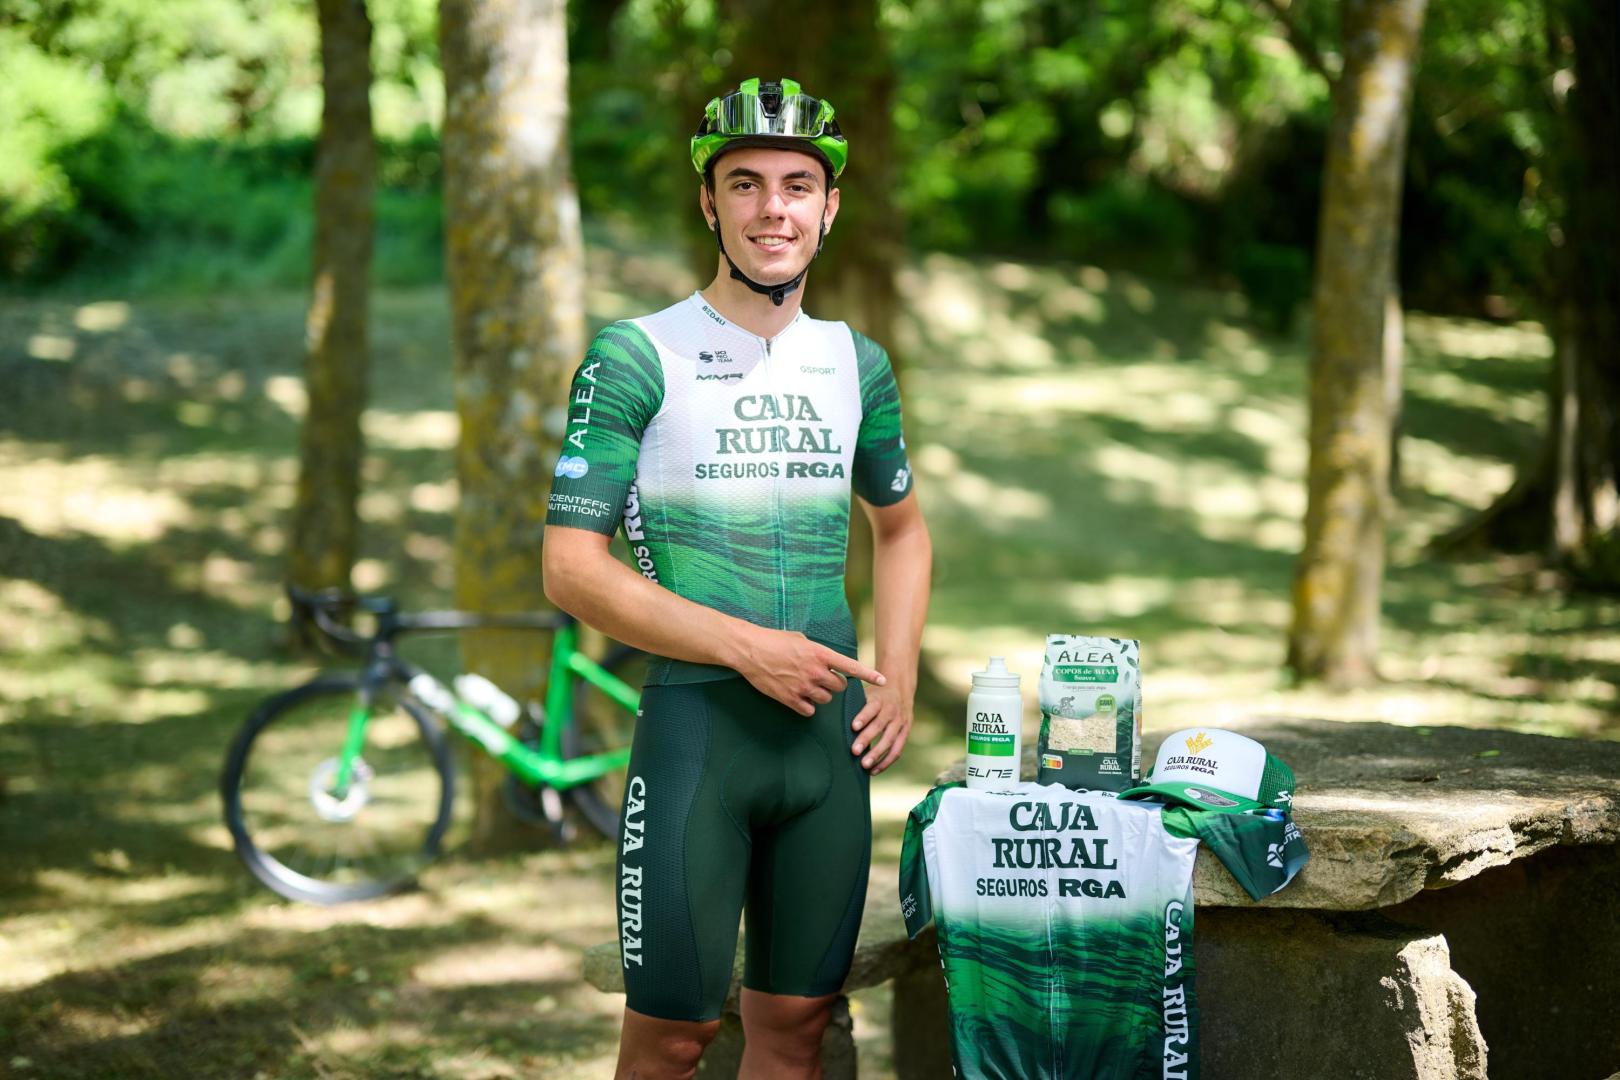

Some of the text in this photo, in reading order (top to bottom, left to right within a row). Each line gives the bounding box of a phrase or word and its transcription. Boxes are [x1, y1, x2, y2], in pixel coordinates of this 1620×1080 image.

[696, 373, 743, 381] MMR
[568, 362, 600, 450] ALEA
[734, 393, 822, 422] CAJA
[715, 425, 842, 454] RURAL
[695, 461, 844, 479] SEGUROS RGA
[1058, 650, 1114, 663] ALEA
[976, 712, 1003, 723] CAJA
[972, 722, 1009, 734] RURAL
[968, 767, 1013, 778] ELITE
[1167, 756, 1219, 769] CAJA RURAL
[1190, 766, 1215, 776] RGA
[1009, 801, 1099, 833] CAJA
[991, 838, 1118, 870] RURAL
[621, 776, 646, 969] CAJA RURAL
[976, 877, 1126, 899] SEGUROS RGA
[1164, 901, 1184, 979] CAJA
